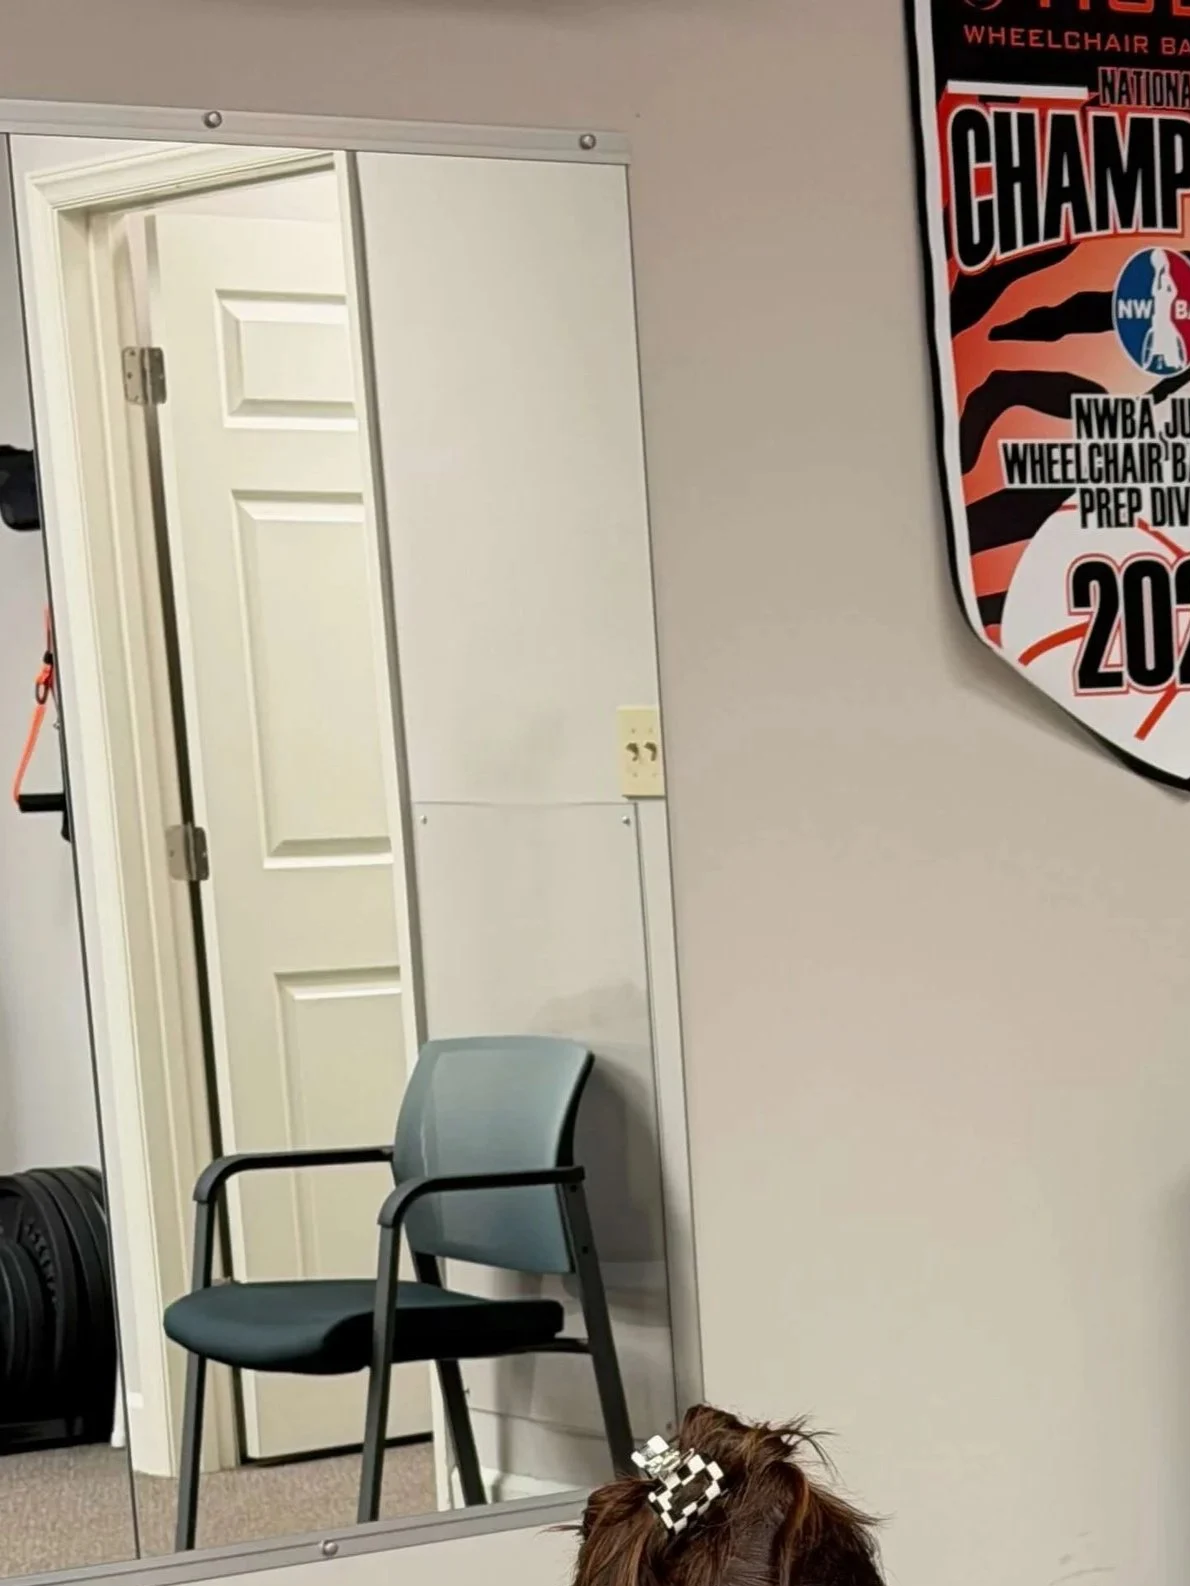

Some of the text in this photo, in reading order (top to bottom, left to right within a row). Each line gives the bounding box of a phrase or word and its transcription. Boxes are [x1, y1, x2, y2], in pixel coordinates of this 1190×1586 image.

[963, 24, 1149, 54] WHEELCHAIR
[1117, 298, 1153, 320] NW
[1075, 396, 1156, 440] NWBA
[1001, 441, 1164, 485] WHEELCHAIR
[1079, 486, 1143, 529] PREP
